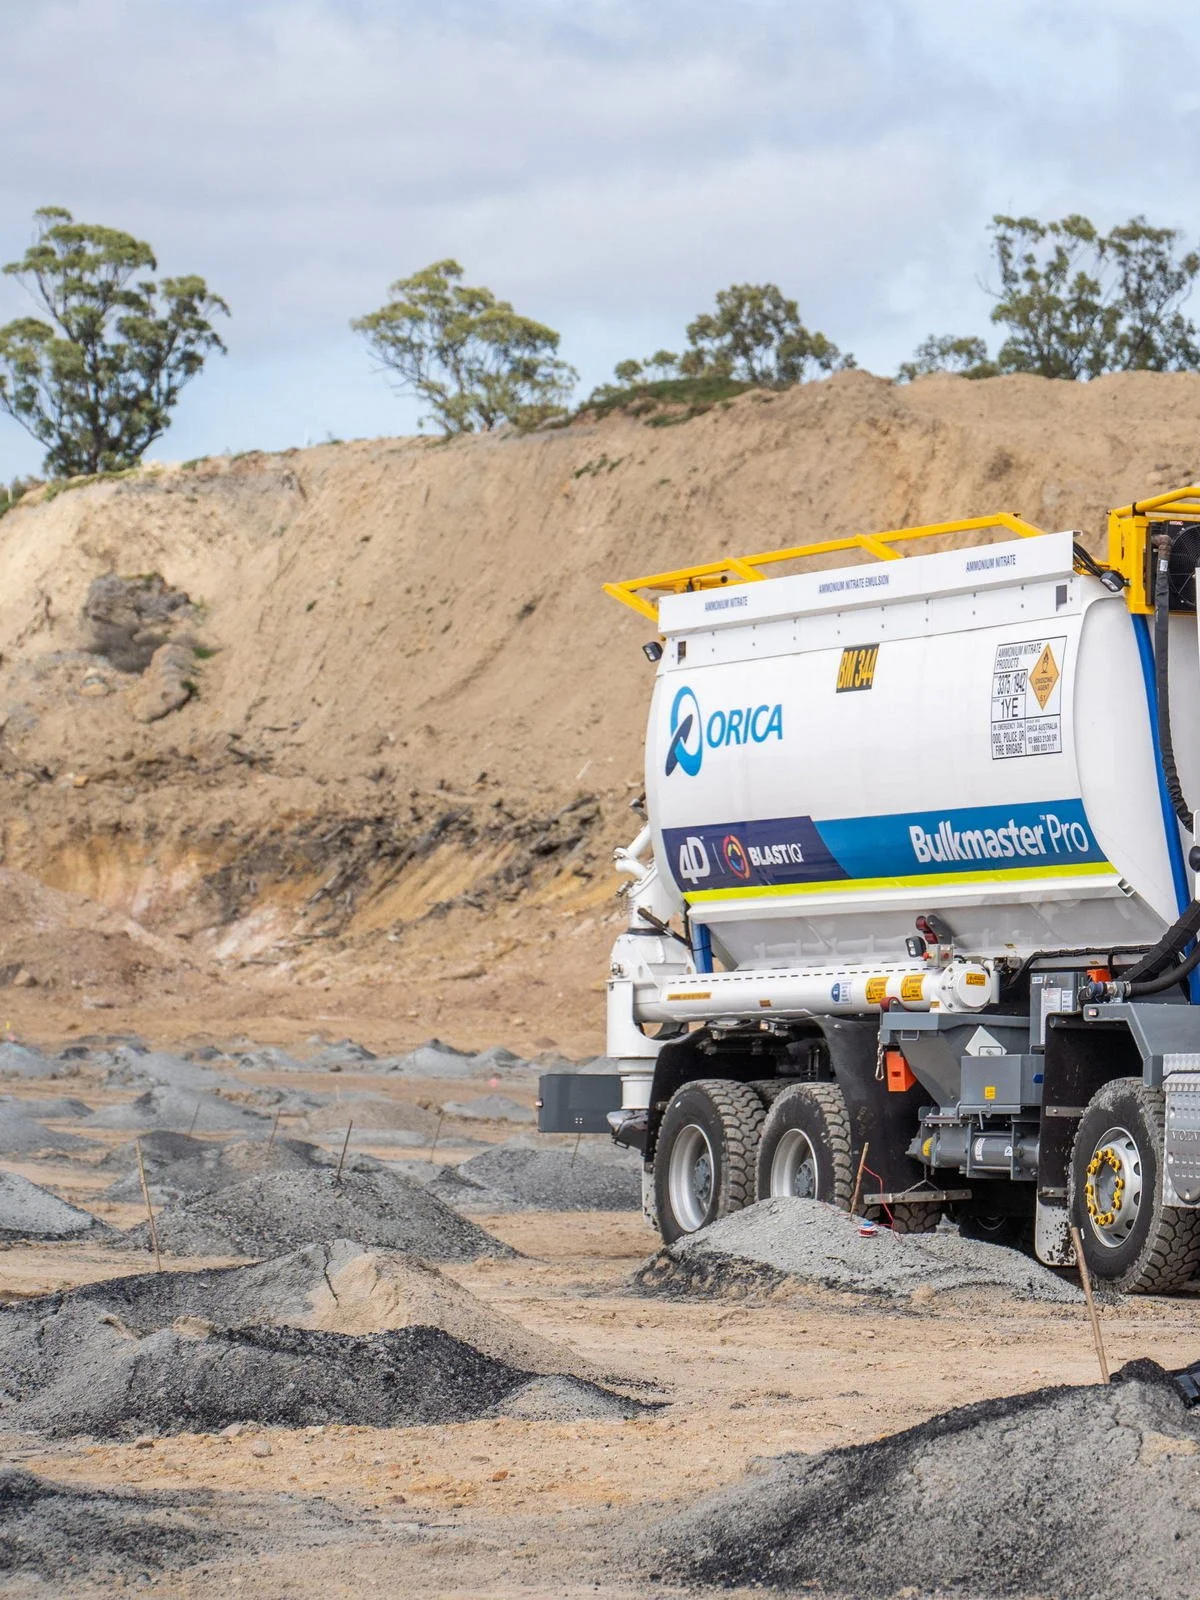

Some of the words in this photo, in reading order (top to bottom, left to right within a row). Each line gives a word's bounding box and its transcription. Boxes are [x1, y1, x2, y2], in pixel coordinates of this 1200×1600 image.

[966, 558, 994, 572] AMMONIUM
[995, 554, 1016, 568] NITRATE
[845, 578, 864, 589] NITRATE
[865, 575, 889, 588] EMULSION
[704, 600, 729, 611] AMMONIUM
[730, 596, 748, 607] NITRATE
[998, 645, 1023, 658] AMMONIUM
[1023, 642, 1041, 655] NITRATE
[838, 650, 859, 689] BM
[854, 648, 878, 688] 344
[996, 657, 1019, 669] PRODUCTS
[1001, 697, 1018, 719] 1YE
[706, 704, 783, 748] ORICA
[1003, 731, 1017, 743] POLICE
[1005, 742, 1022, 755] BRIGADE
[1045, 814, 1090, 854] Pro
[679, 836, 711, 884] 4D
